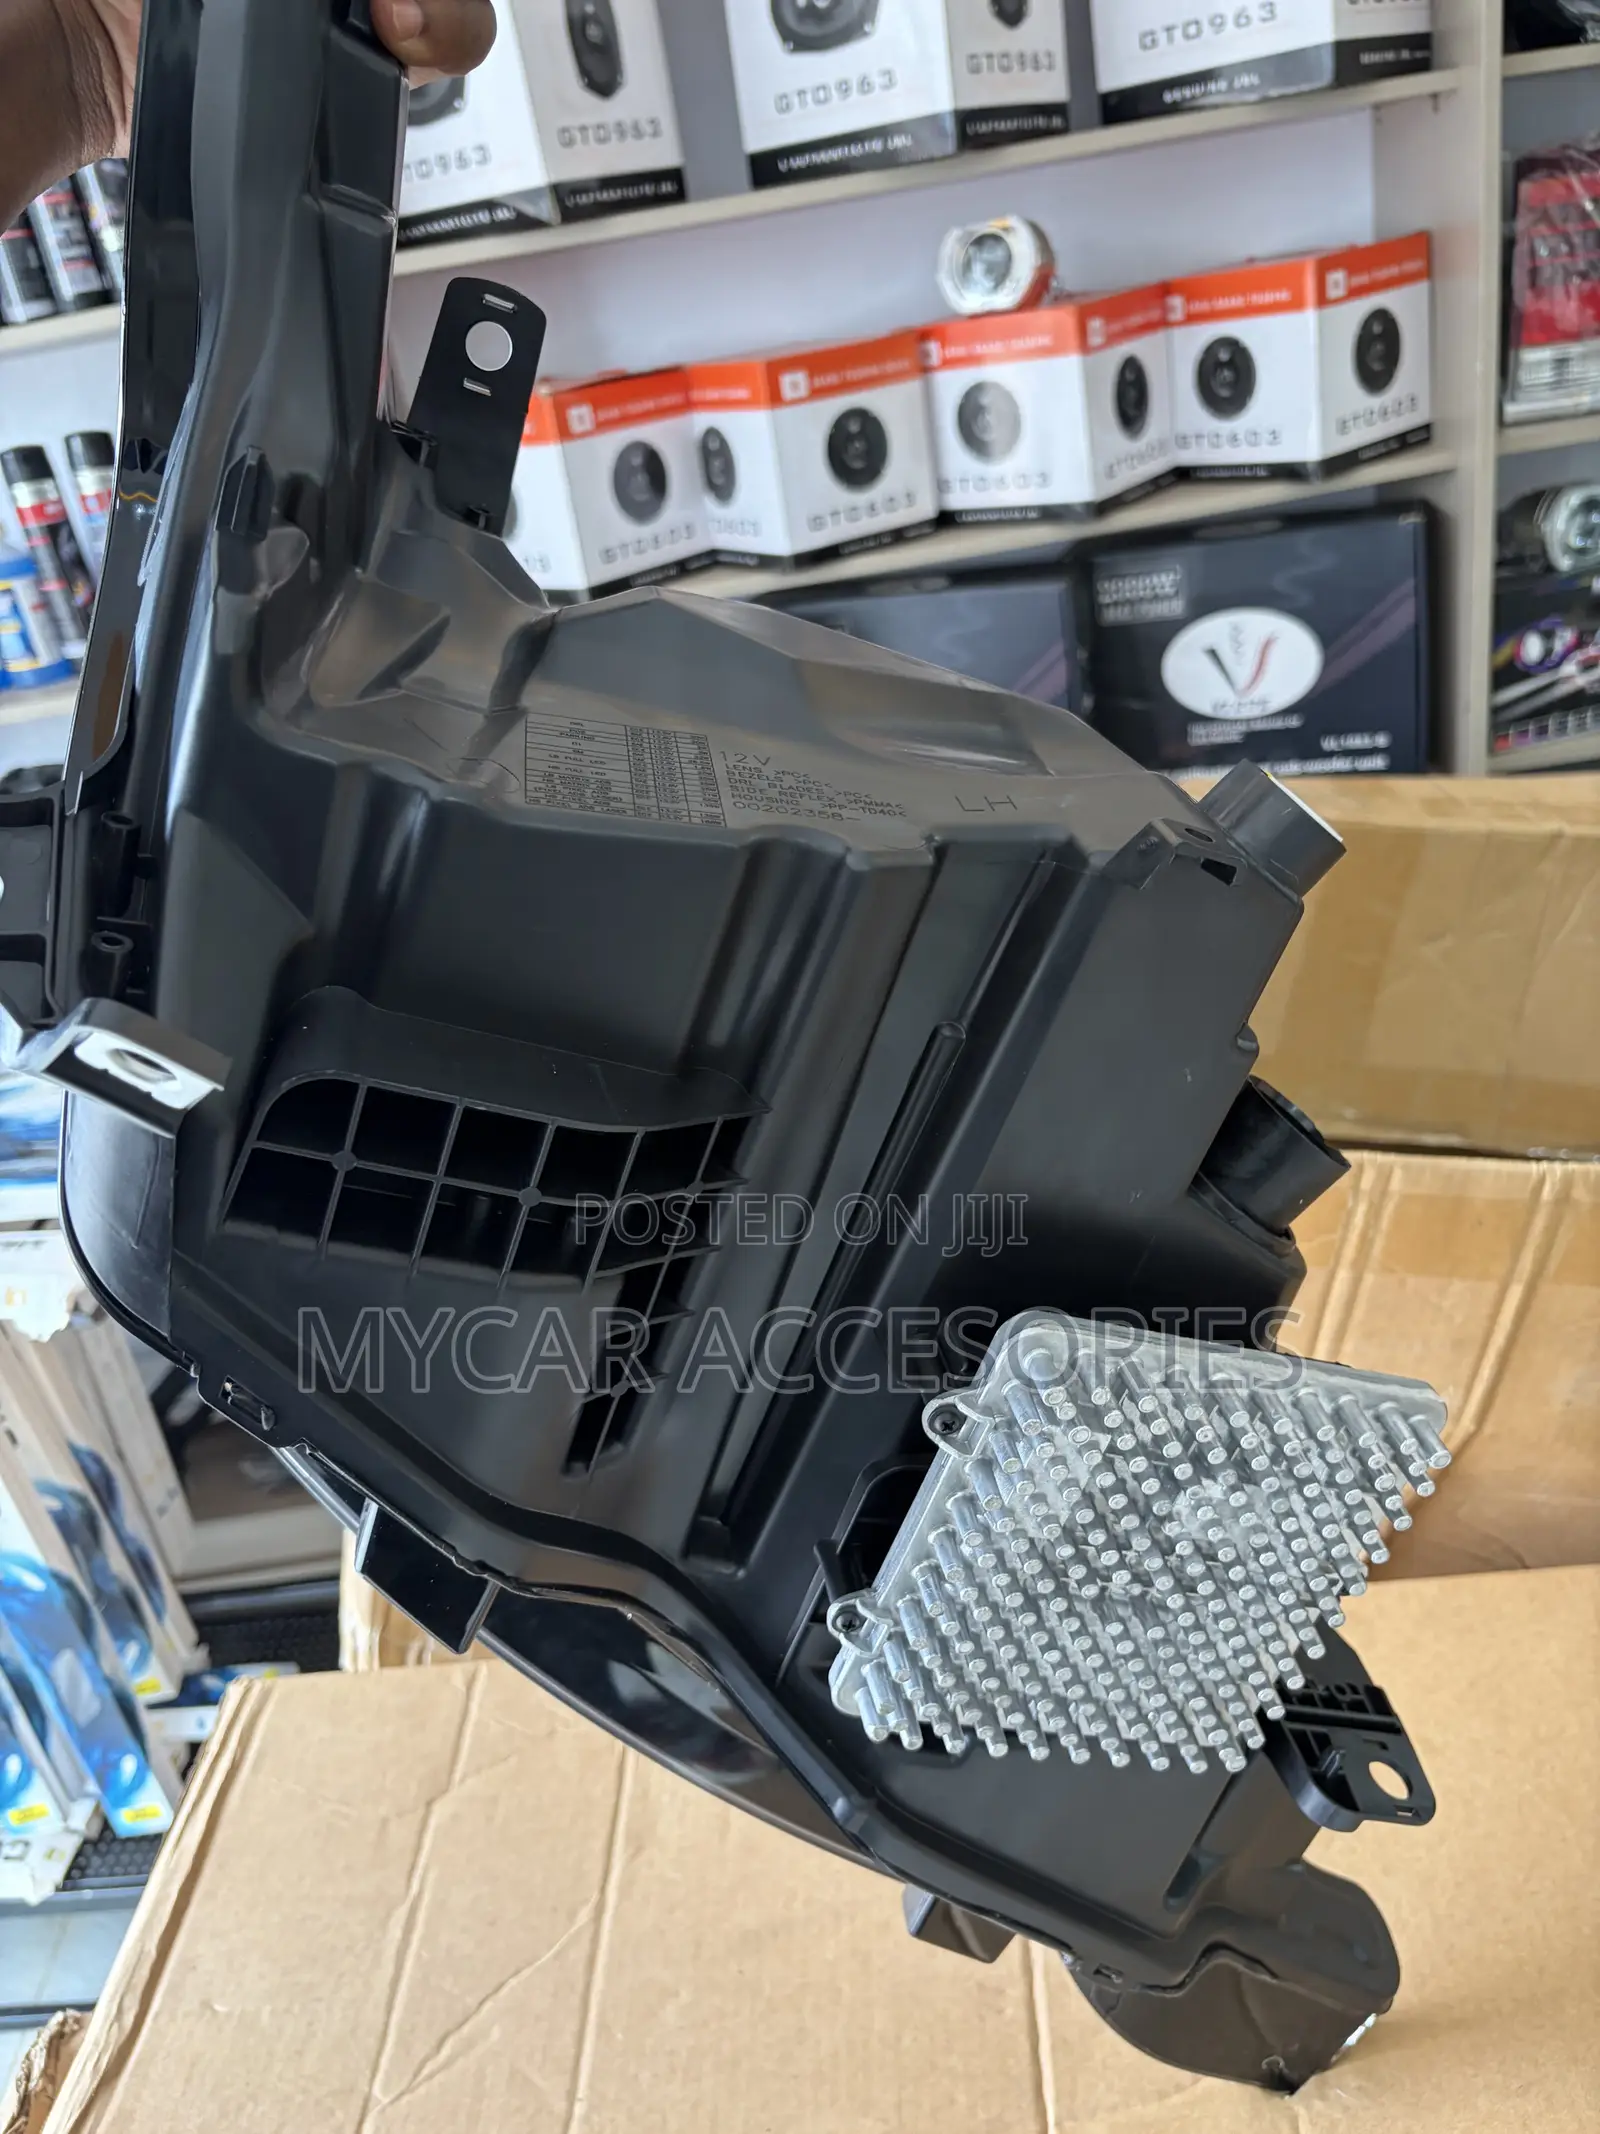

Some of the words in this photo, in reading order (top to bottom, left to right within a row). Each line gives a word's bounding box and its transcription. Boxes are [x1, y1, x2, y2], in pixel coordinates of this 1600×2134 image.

[1138, 1, 1277, 51] GTO963
[774, 68, 898, 115] GTO963
[720, 750, 772, 766] 12V
[725, 763, 763, 774] LENS
[726, 770, 784, 783] BEZELS
[729, 784, 769, 795] SIDE
[778, 791, 837, 803] REFLEX
[767, 782, 825, 795] BLADES
[731, 792, 801, 807] HOUSING
[954, 794, 1018, 812] LH
